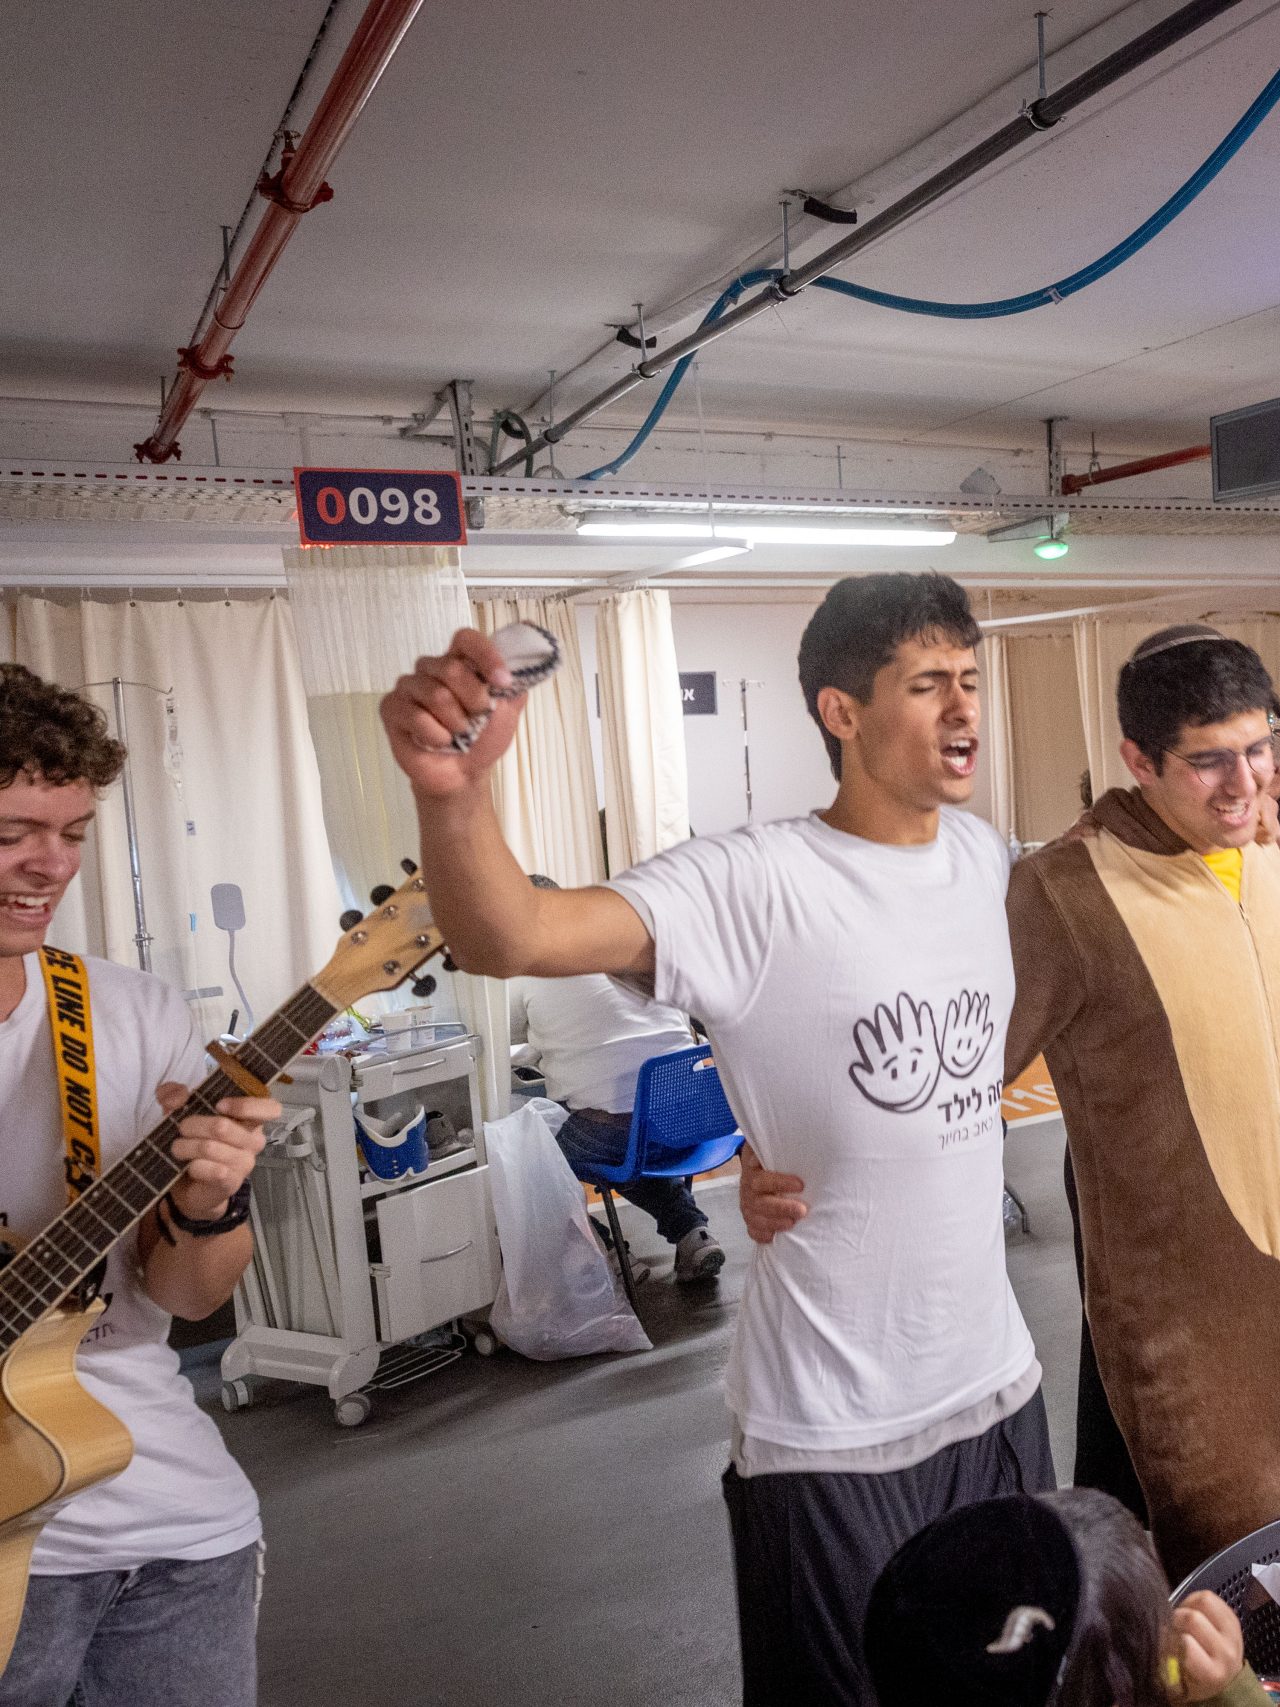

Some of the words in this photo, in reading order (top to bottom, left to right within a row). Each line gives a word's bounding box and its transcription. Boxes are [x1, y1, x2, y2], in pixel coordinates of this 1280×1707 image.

[316, 486, 442, 526] 0098
[51, 974, 87, 1033] LINE
[60, 1031, 90, 1075] DO
[64, 1077, 94, 1137] NOT
[937, 1087, 982, 1123] לילד
[937, 1126, 970, 1151] בחיוך
